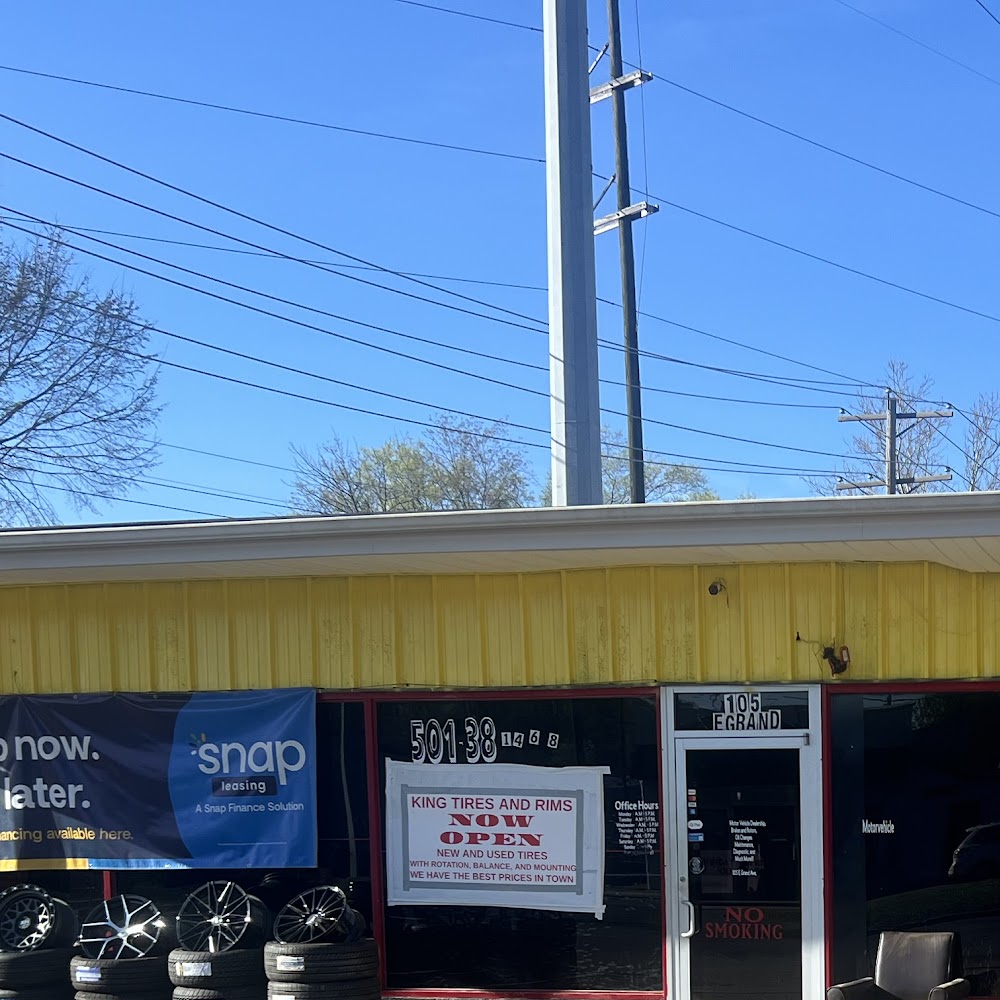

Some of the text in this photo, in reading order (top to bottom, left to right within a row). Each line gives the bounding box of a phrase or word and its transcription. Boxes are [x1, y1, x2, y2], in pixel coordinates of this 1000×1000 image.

[726, 694, 760, 713] 105
[14, 735, 100, 762] now.
[198, 740, 306, 786] snap
[4, 777, 91, 810] later.
[222, 780, 266, 793] leasing
[195, 801, 304, 814] A Snap Finance Solution
[411, 796, 573, 812] KING TIRES AND RIMS
[614, 800, 659, 810] Office Hours
[448, 813, 535, 828] NOW
[46, 827, 96, 841] available
[99, 827, 133, 841] here.
[439, 831, 544, 847] OPEN
[437, 849, 548, 860] NEW AND USED TIRES
[409, 860, 577, 872] WITH ROTATION, BALANCE, AND MOUNTING
[410, 871, 574, 883] WE HAVE THE BEST PRICES IN TOWN
[726, 906, 764, 922] NO
[705, 922, 784, 940] SMOKING
